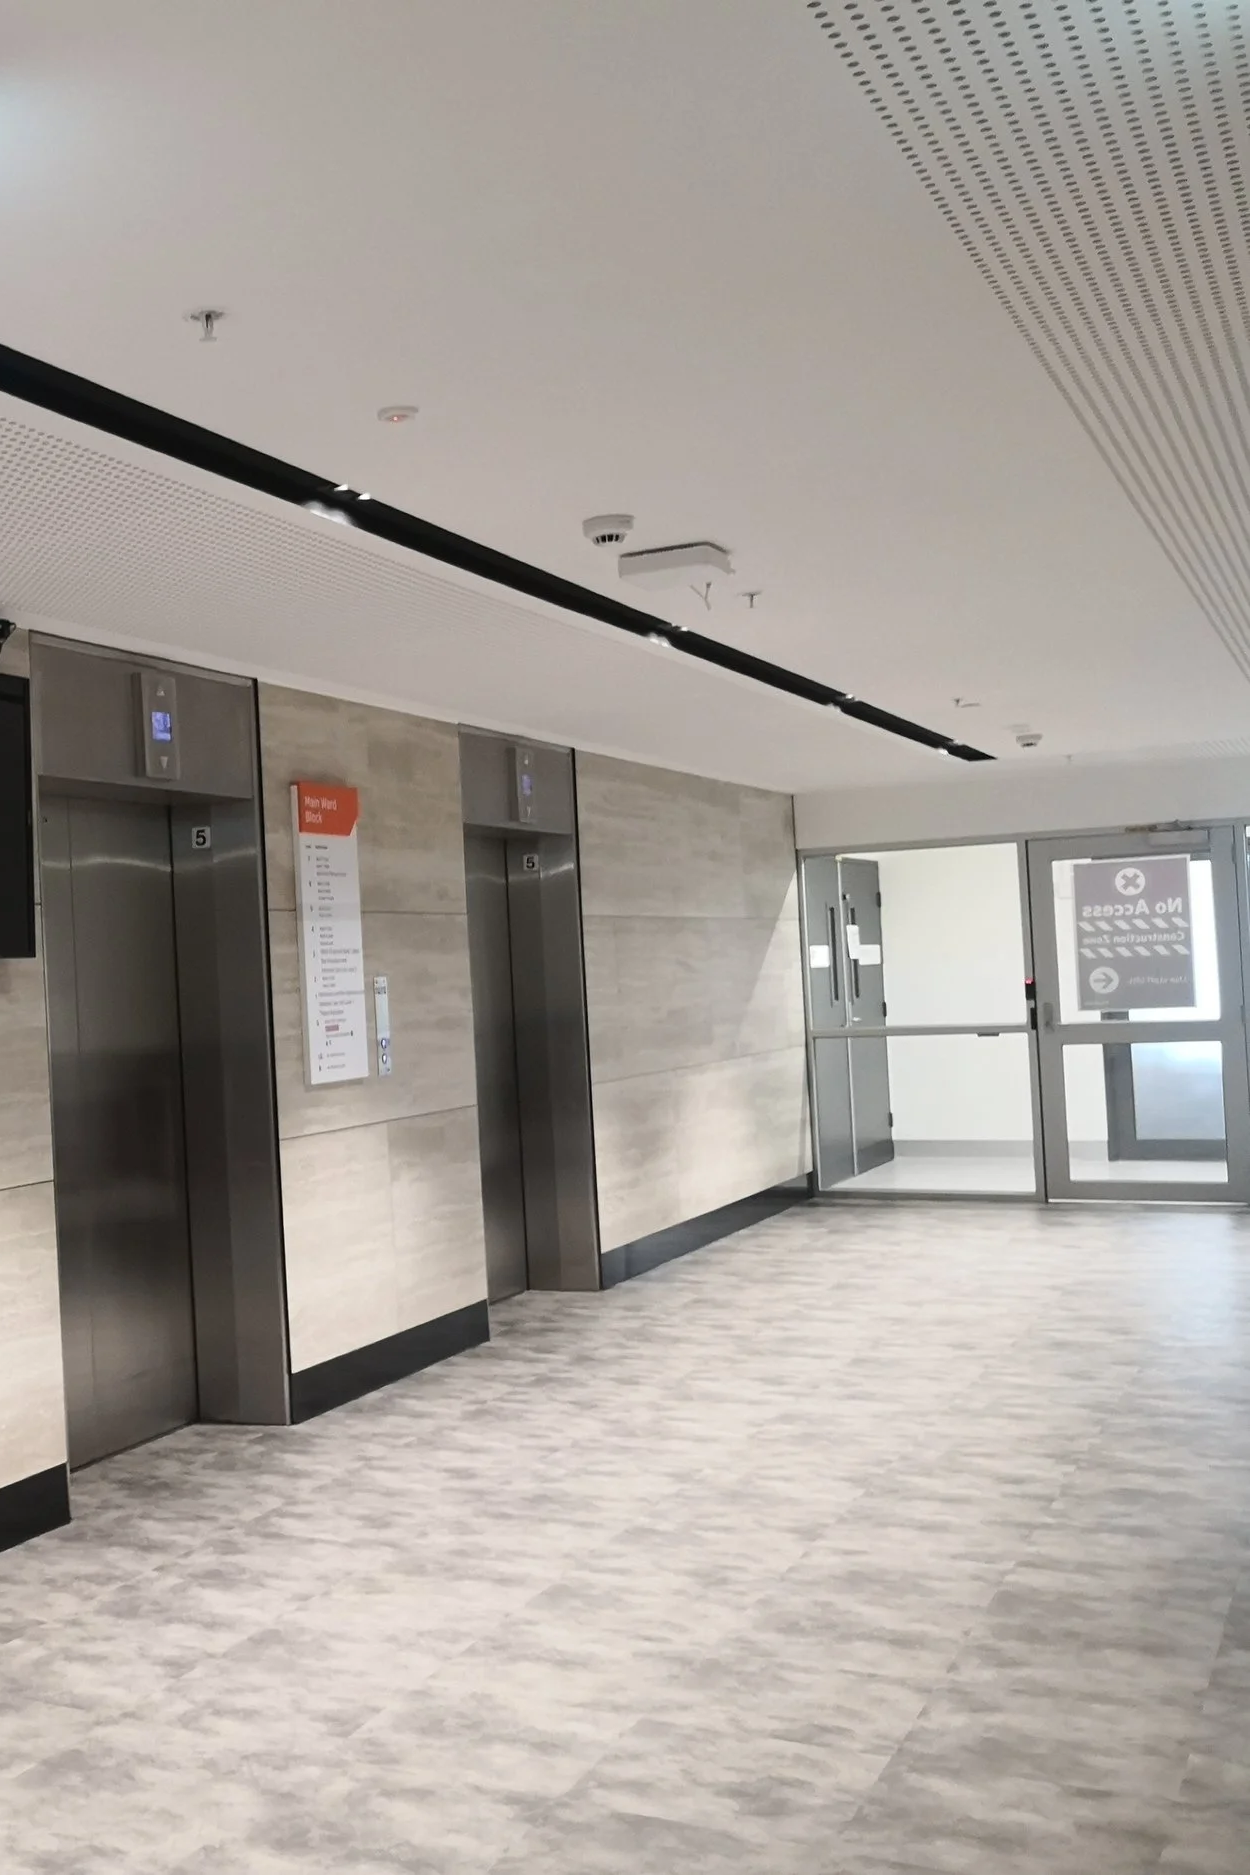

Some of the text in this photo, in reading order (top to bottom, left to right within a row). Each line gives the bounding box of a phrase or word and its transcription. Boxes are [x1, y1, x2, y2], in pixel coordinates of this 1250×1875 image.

[304, 795, 337, 811] Main Ward
[195, 829, 207, 846] 5
[526, 856, 535, 869] 5
